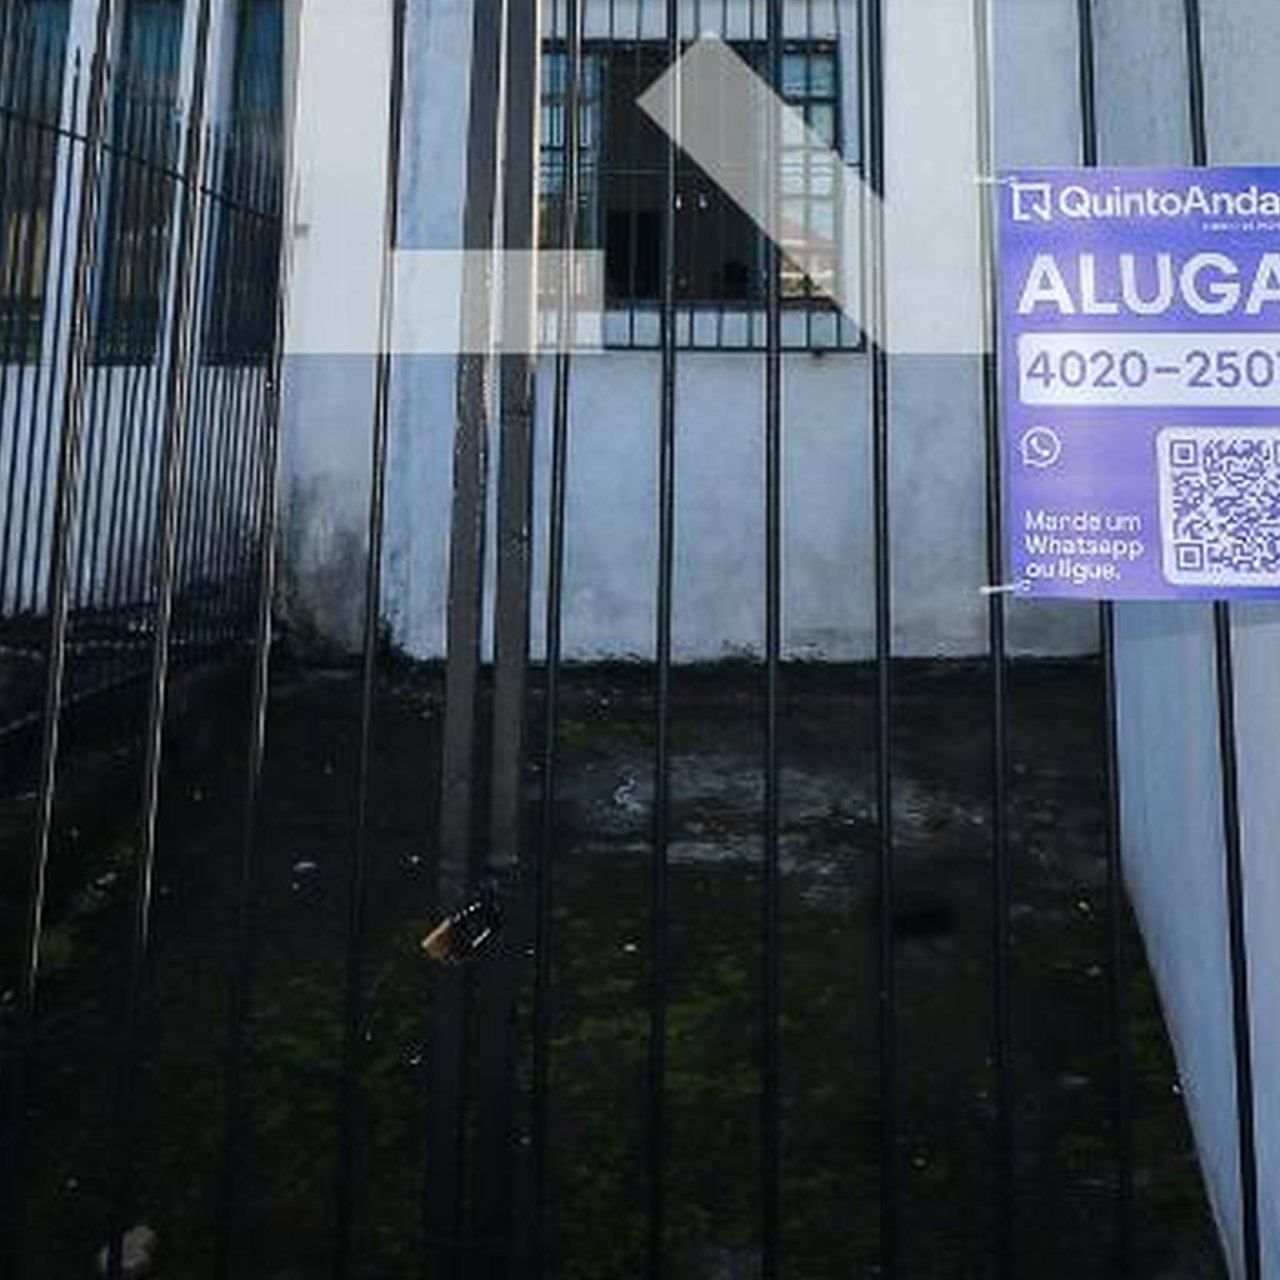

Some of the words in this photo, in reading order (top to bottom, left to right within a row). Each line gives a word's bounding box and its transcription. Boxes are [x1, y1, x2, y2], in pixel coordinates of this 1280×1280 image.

[1025, 510, 1101, 532] Manda
[1105, 515, 1141, 532] um
[1025, 535, 1144, 561] Whatsapp
[1025, 563, 1055, 579] ou
[1058, 559, 1121, 584] ligue.
